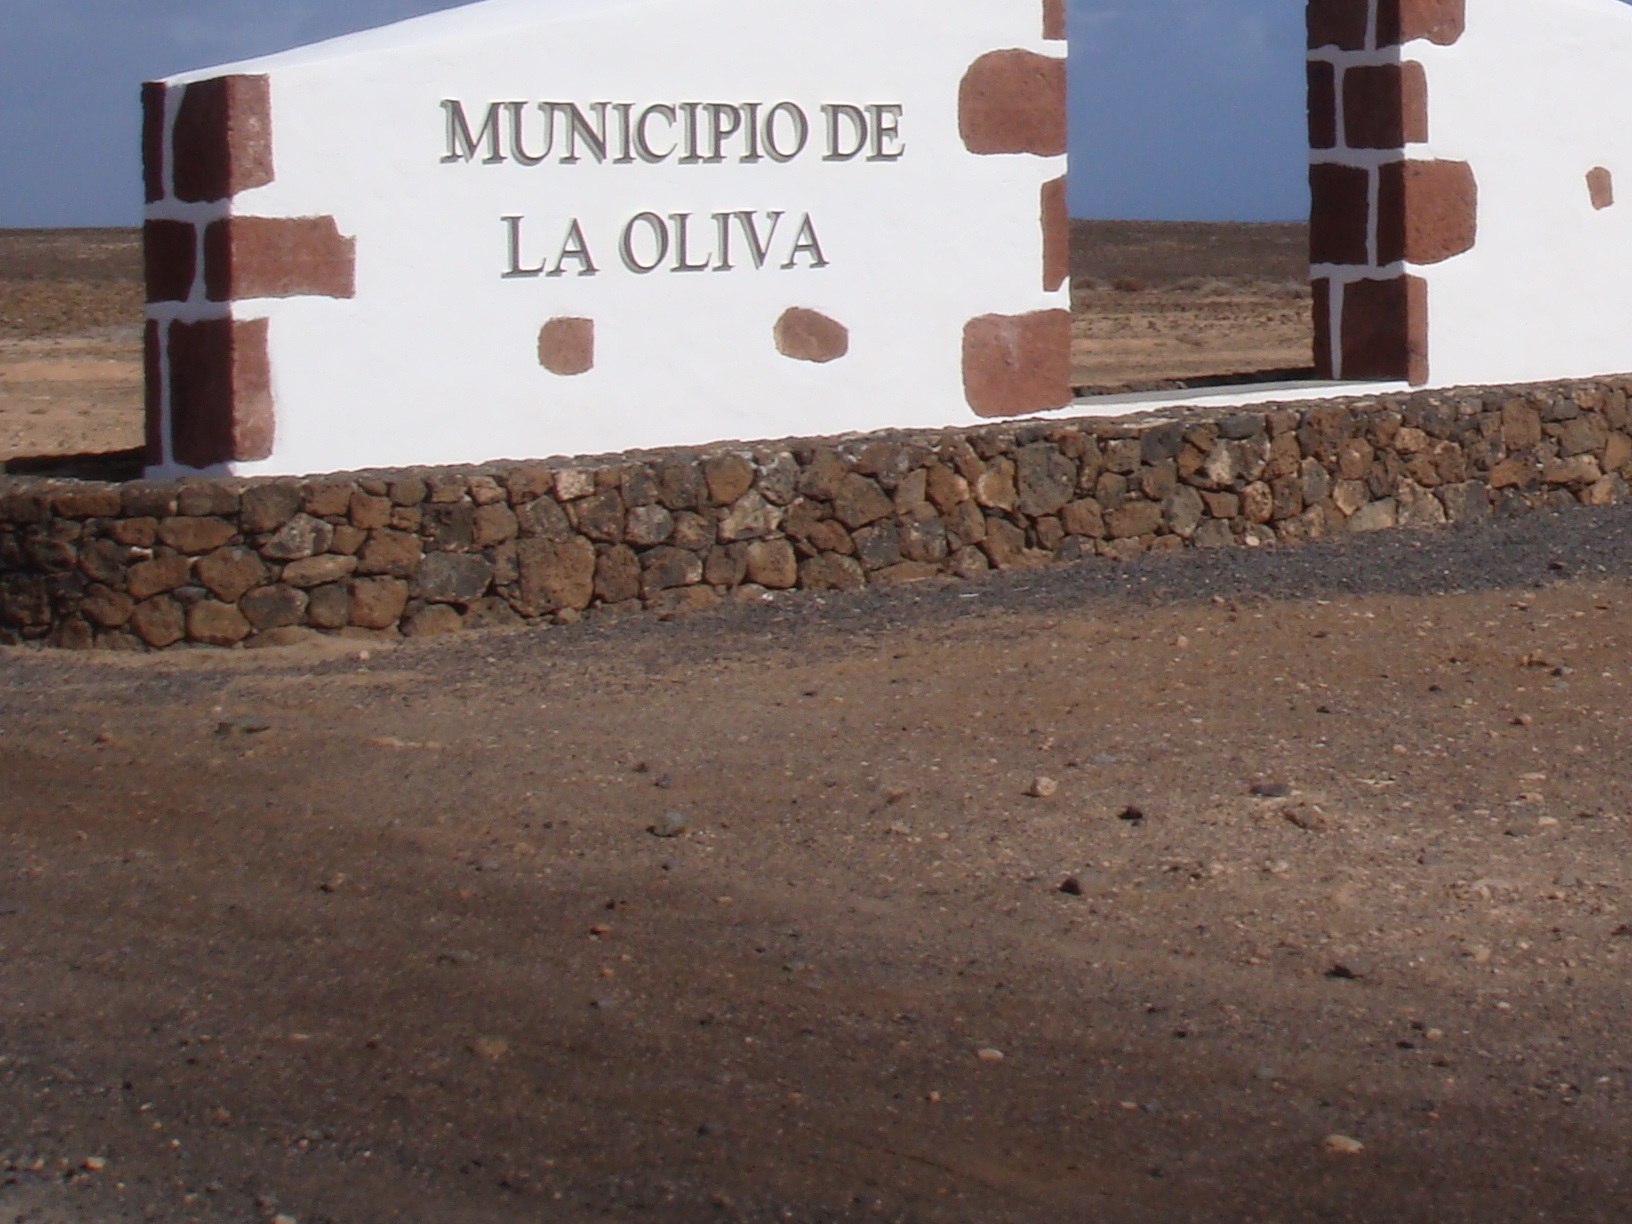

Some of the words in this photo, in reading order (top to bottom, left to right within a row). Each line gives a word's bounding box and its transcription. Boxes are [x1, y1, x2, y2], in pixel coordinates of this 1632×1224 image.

[439, 99, 810, 167] MUNICIPIO
[820, 103, 906, 163] DE
[500, 214, 600, 279] LA
[618, 210, 830, 275] OLIVA
